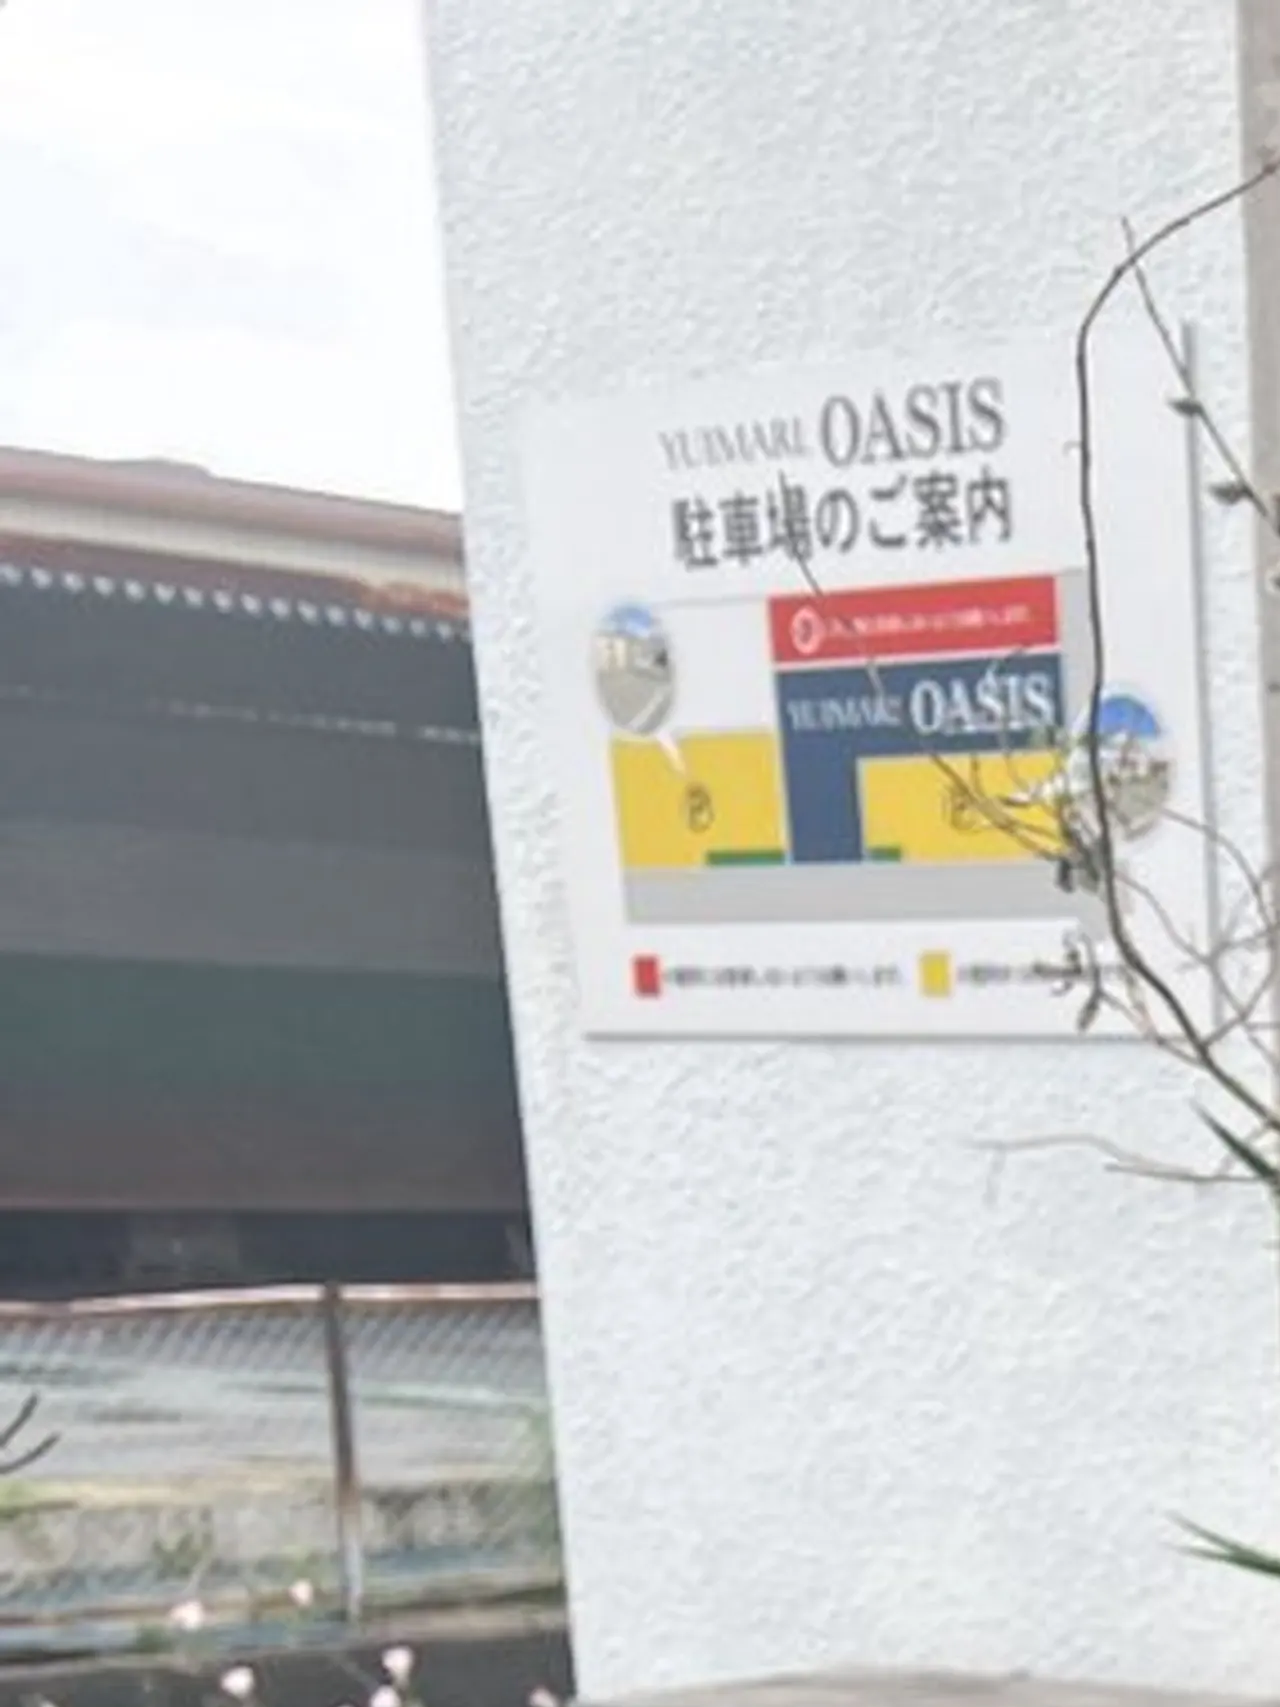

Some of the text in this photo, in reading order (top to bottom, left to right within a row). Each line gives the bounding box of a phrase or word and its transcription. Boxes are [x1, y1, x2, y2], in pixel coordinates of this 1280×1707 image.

[818, 376, 1005, 467] OASIS
[671, 465, 1012, 571] 駐車場のご案内
[909, 671, 1055, 735] OASIS
